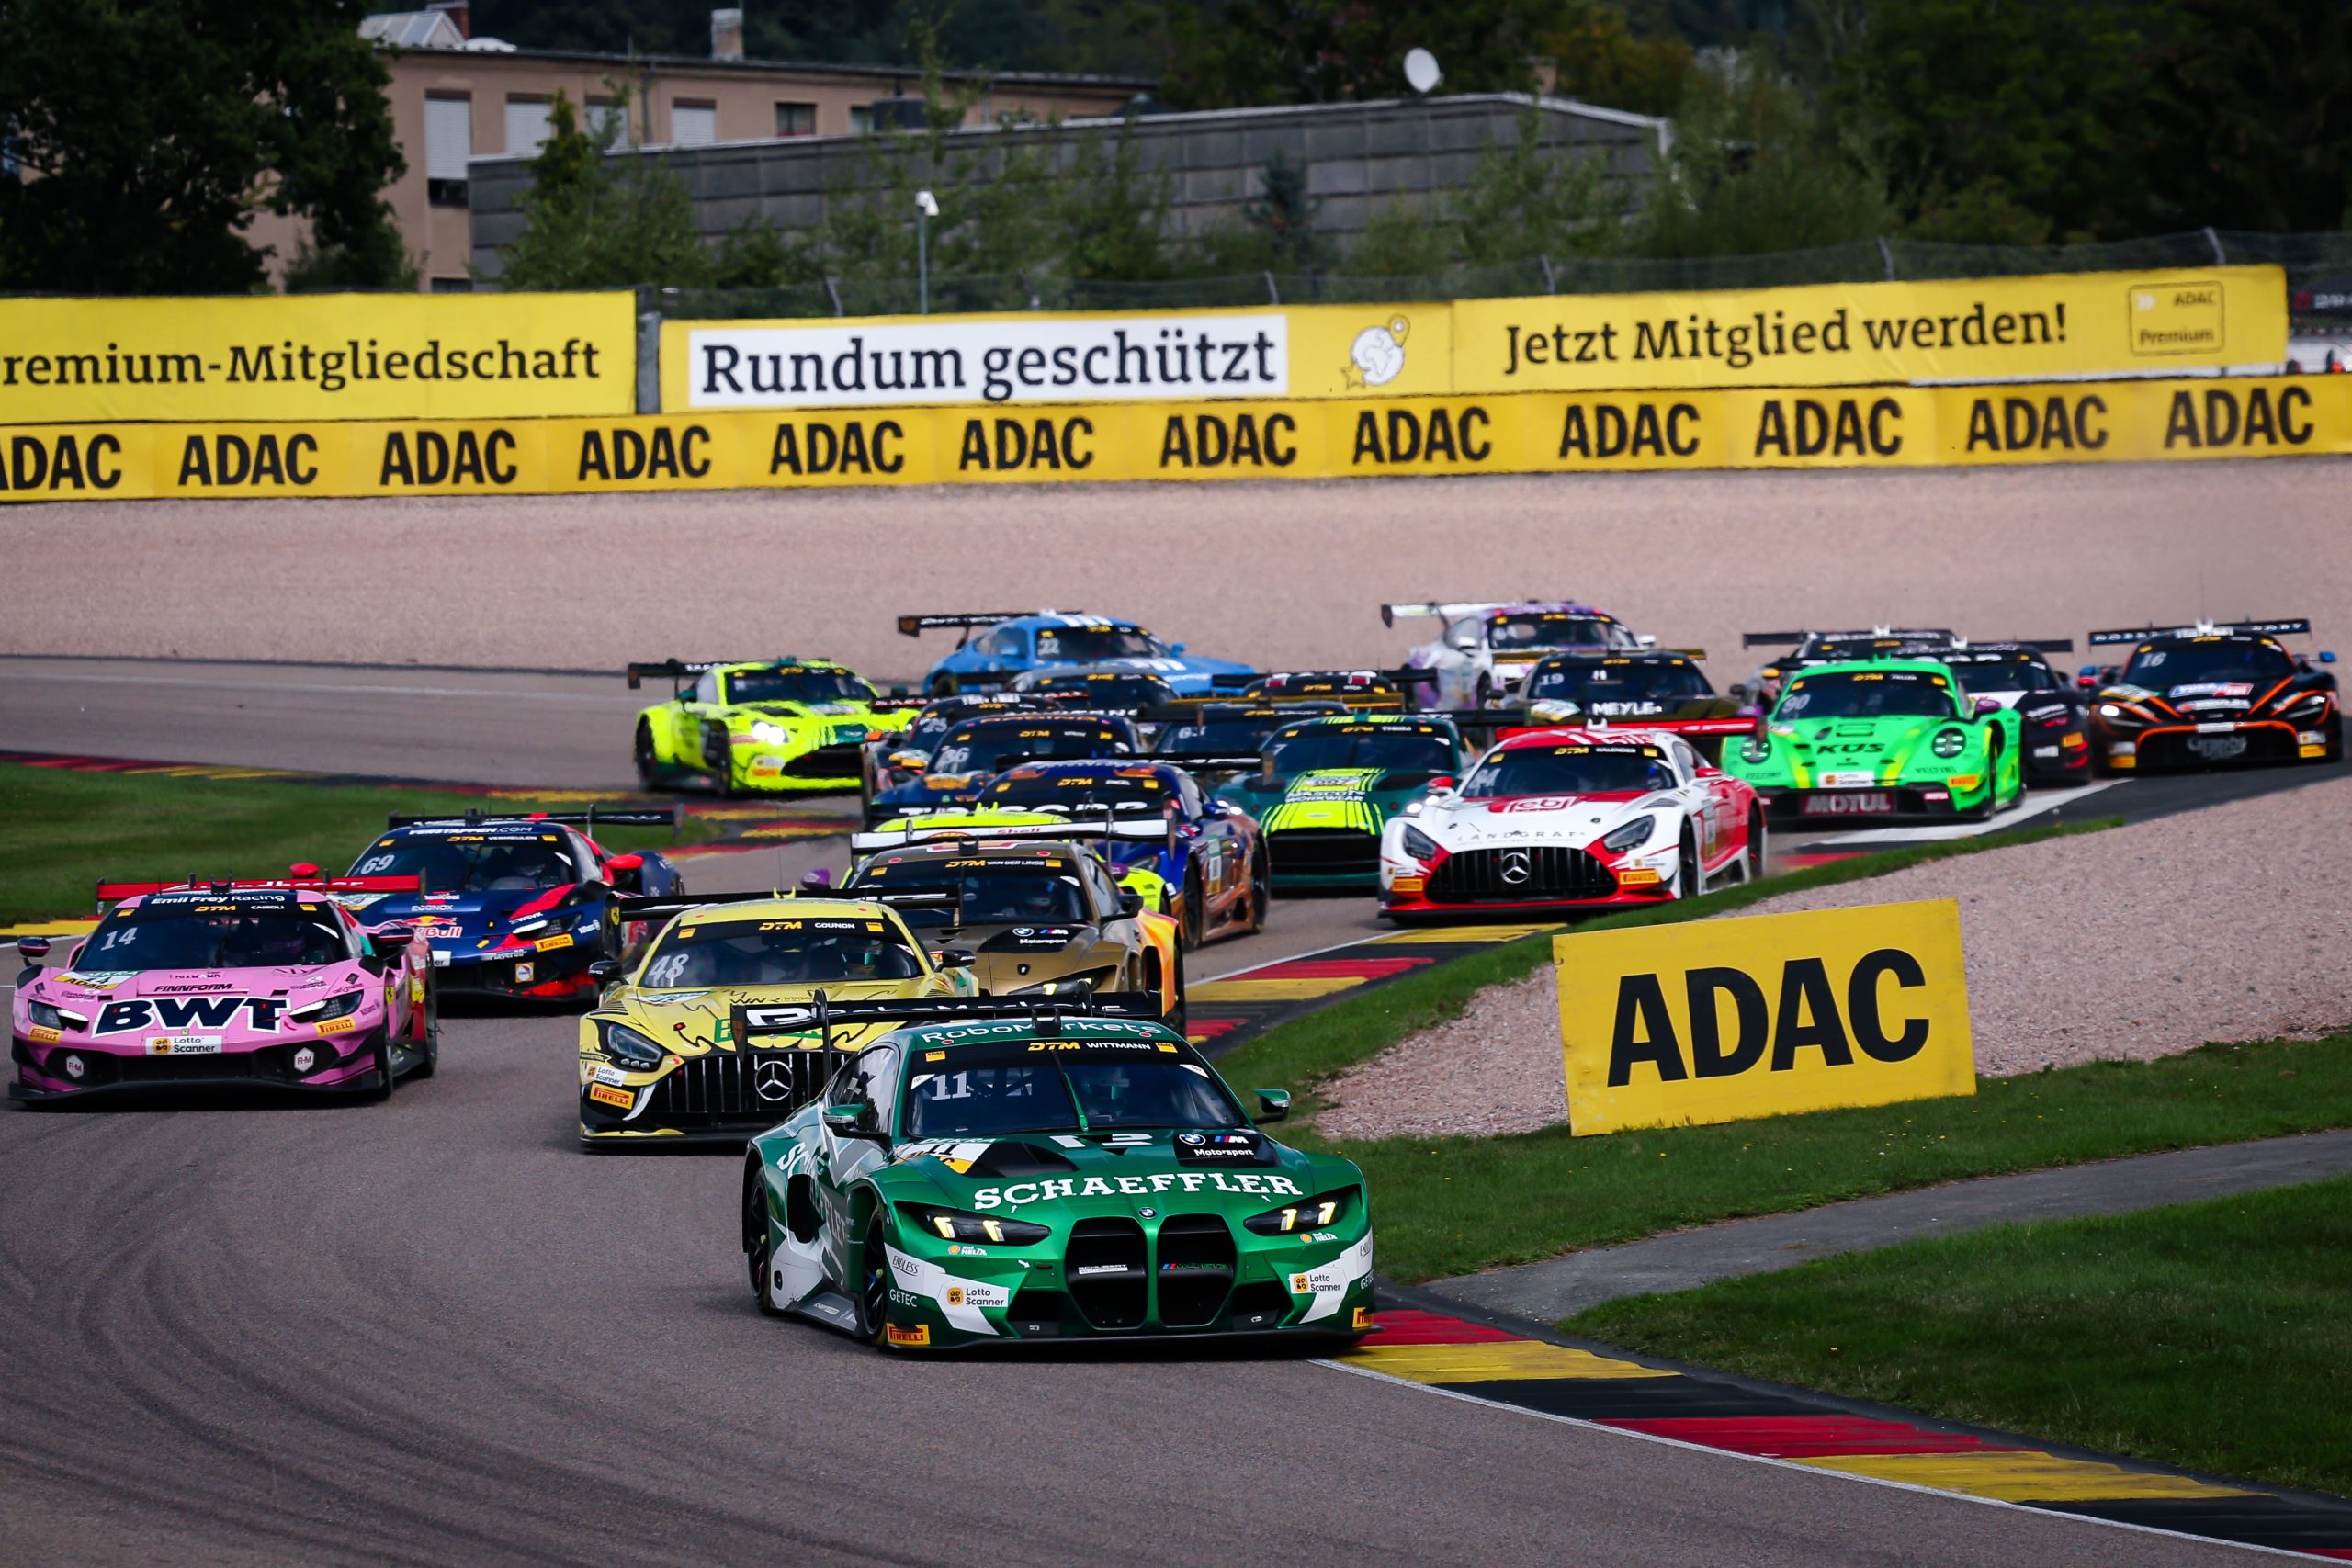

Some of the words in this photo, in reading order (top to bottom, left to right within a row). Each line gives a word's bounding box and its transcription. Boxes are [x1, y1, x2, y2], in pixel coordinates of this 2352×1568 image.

[1505, 323, 1617, 375] Jetzt
[1633, 310, 1849, 368] Mitglied
[1863, 302, 2066, 350] werden!
[703, 337, 966, 393] Rundum
[982, 330, 1276, 401] geschützt
[1756, 398, 1903, 457] ADAC
[1967, 396, 2108, 451] ADAC
[2164, 387, 2313, 449] ADAC
[1160, 413, 1297, 468] ADAC
[1352, 406, 1491, 464] ADAC
[1559, 403, 1700, 458] ADAC
[578, 425, 711, 481] ADAC
[770, 420, 904, 475] ADAC
[960, 417, 1093, 470] ADAC
[178, 434, 318, 486] ADAC
[380, 429, 517, 486] ADAC
[1804, 792, 1891, 814] MOTUL
[361, 854, 395, 874] 69
[945, 860, 986, 868] DTM
[232, 894, 286, 903] Racing
[759, 921, 802, 931] DTM
[100, 927, 138, 951] 14
[648, 954, 688, 979] 48
[64, 978, 108, 989] ADAC
[154, 983, 233, 992] FINNFORM
[92, 997, 291, 1037] BWT
[319, 1020, 353, 1033] PIRELLI
[1607, 948, 1930, 1088] ADAC
[1028, 1042, 1080, 1051] DTM
[596, 1073, 622, 1085] Scanner
[598, 1067, 616, 1076] Lotto
[594, 1087, 628, 1105] PIRELLI
[930, 1072, 972, 1101] 11
[928, 1144, 956, 1156] 11
[1193, 1148, 1254, 1156] Motorsport
[974, 1172, 1304, 1210] SCHAEFFLER
[961, 1247, 987, 1256] HELIX
[892, 1255, 920, 1274] ENDLESS
[1309, 1274, 1330, 1282] Lotto
[1310, 1283, 1340, 1292] Scanner
[889, 1289, 917, 1307] GETEC
[966, 1288, 990, 1296] Lotto
[966, 1296, 1004, 1305] Scanner
[888, 1327, 924, 1341] PIRELLI
